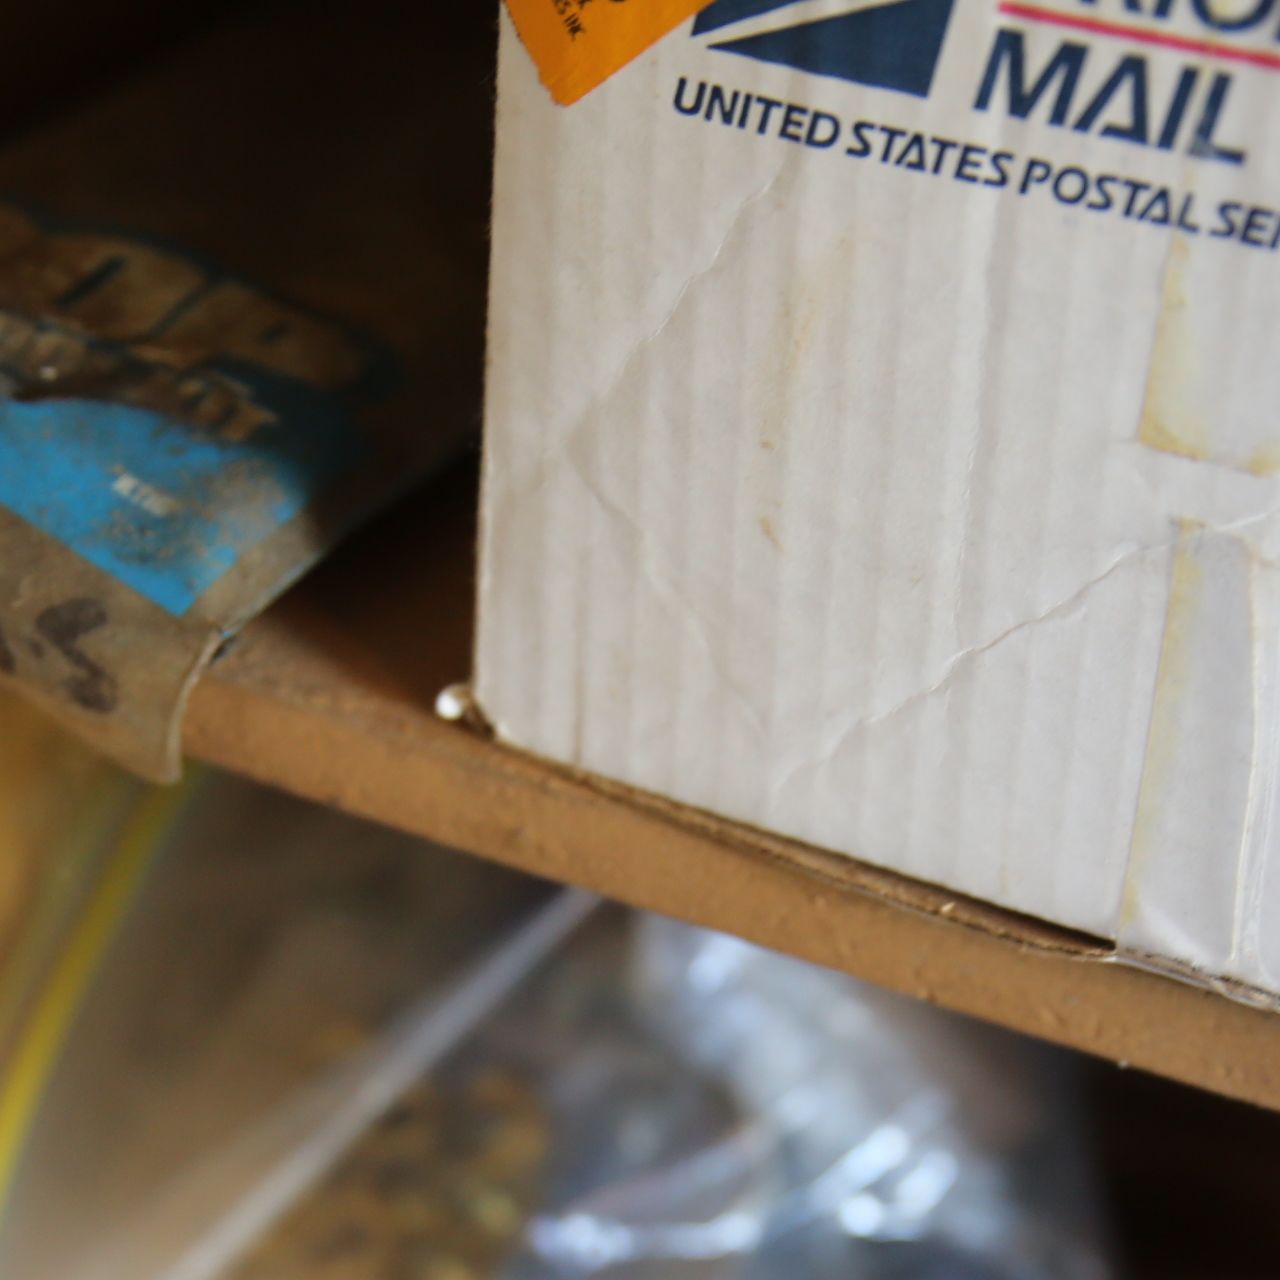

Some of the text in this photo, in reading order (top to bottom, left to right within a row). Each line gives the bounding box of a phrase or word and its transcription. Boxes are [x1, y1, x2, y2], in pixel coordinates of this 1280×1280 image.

[672, 76, 841, 149] UNITED
[845, 120, 1015, 188] STATES
[1018, 158, 1200, 235] POSTAL
[972, 28, 1247, 165] MAIL
